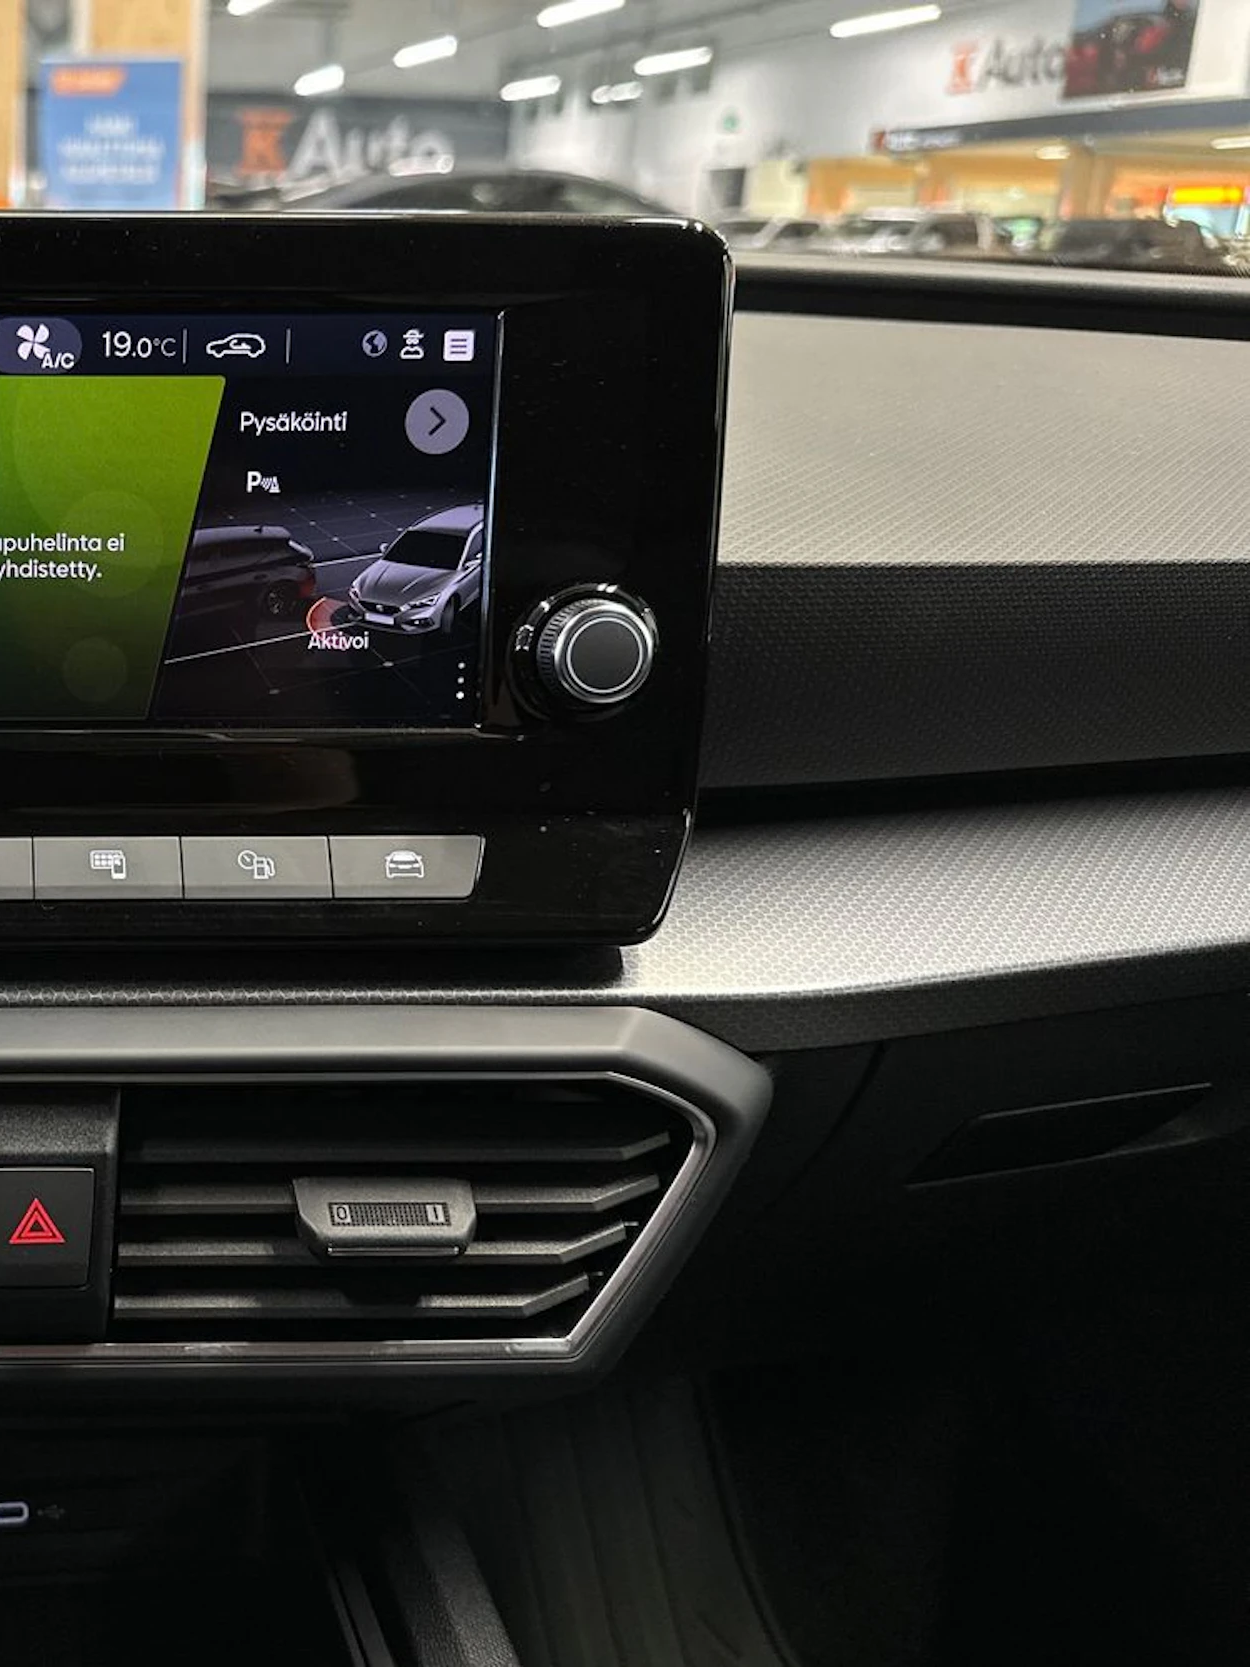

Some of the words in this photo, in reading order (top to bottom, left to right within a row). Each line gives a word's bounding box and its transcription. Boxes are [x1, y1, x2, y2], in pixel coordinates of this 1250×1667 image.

[288, 108, 453, 178] Auto
[102, 330, 177, 358] 19.0°C
[41, 352, 76, 370] A/C
[239, 411, 348, 436] Pysäköinti
[107, 533, 125, 551] ei
[307, 630, 370, 650] Aktivoi
